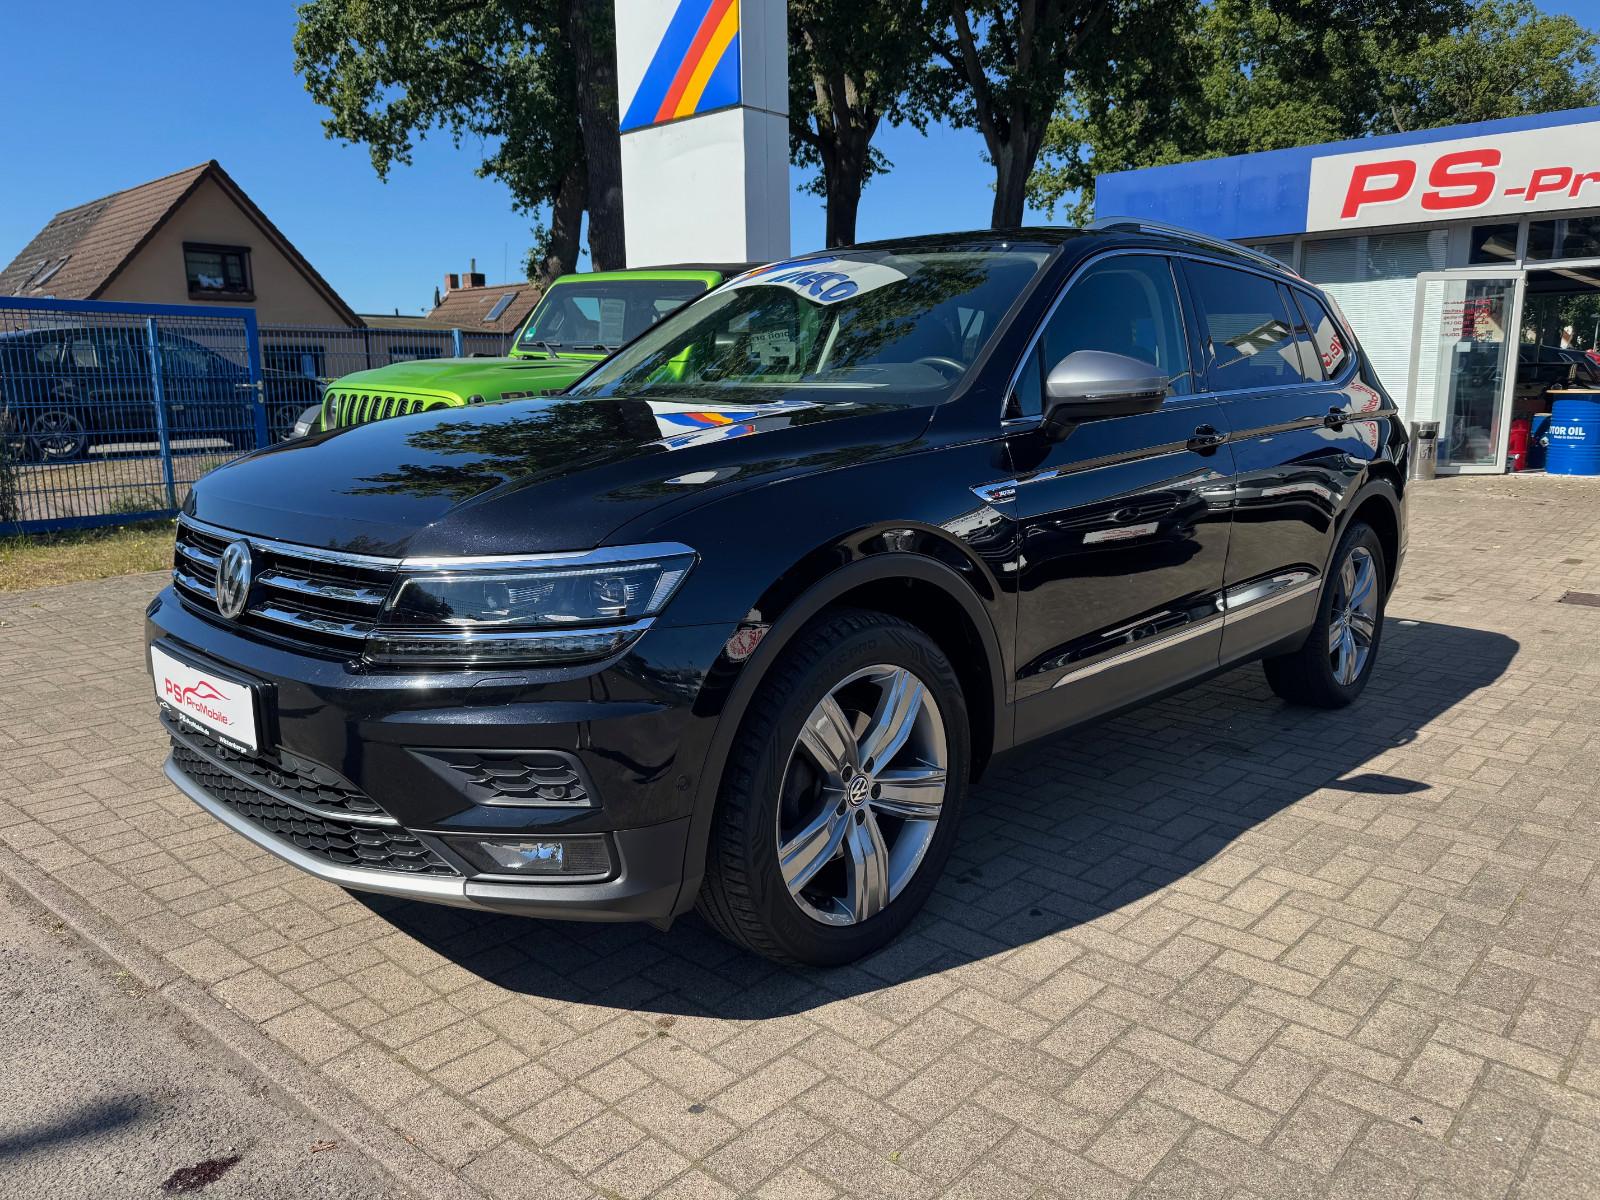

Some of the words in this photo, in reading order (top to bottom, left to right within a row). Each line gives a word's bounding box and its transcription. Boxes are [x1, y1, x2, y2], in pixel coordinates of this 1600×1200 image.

[1568, 426, 1586, 436] OIL
[165, 678, 183, 704] PS
[187, 697, 228, 725] ProMobile
[219, 735, 247, 754] Wittenberge
